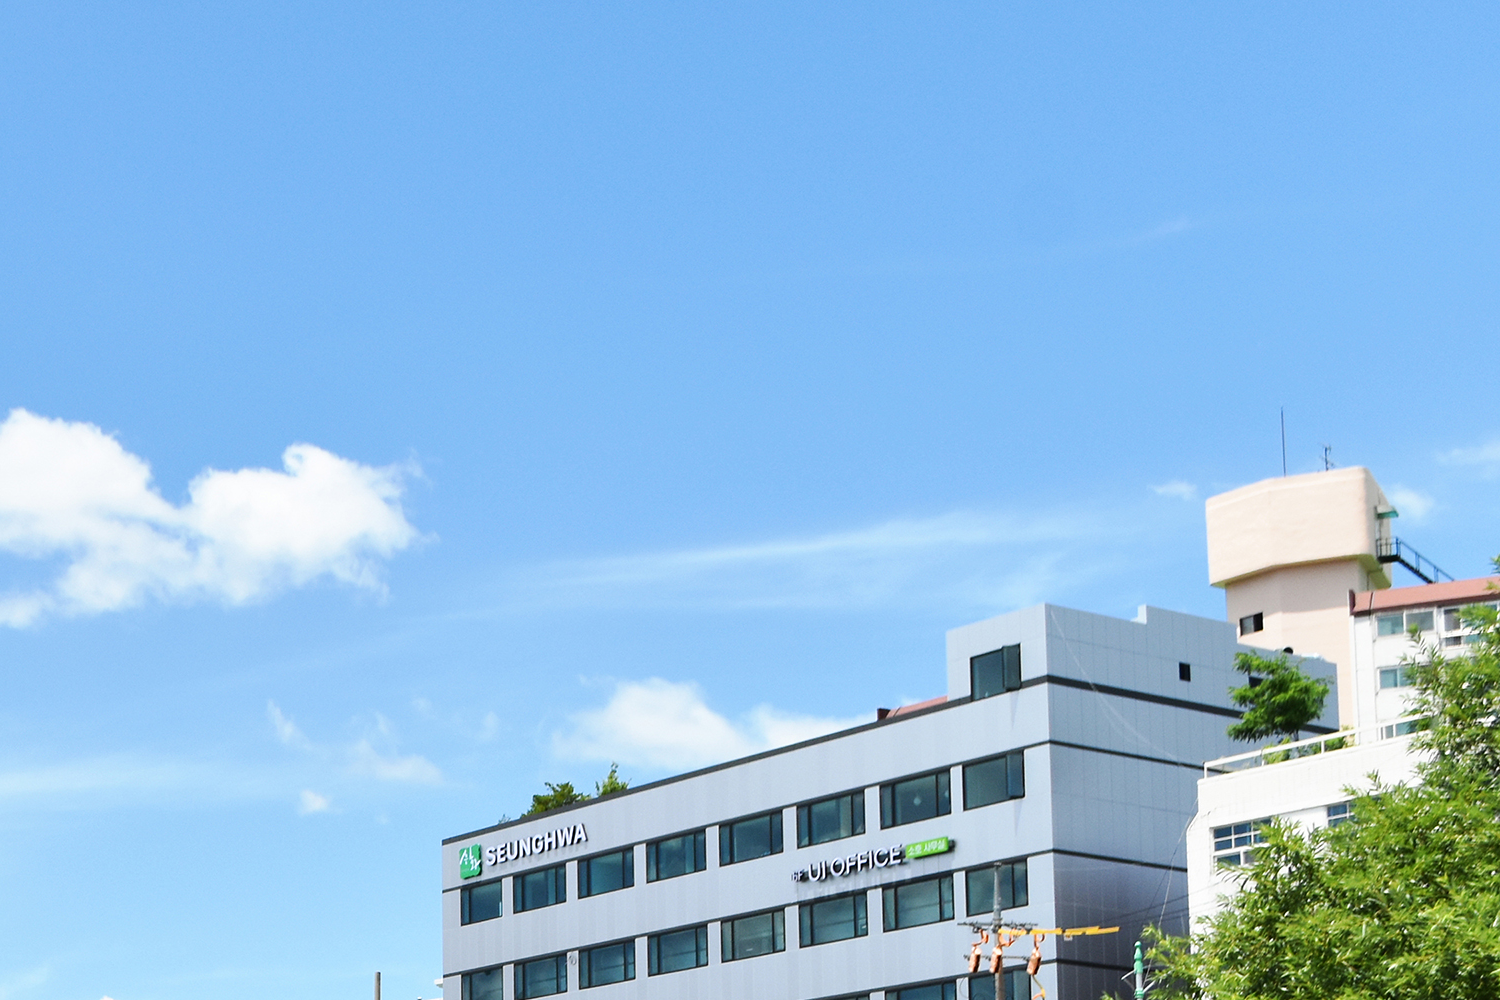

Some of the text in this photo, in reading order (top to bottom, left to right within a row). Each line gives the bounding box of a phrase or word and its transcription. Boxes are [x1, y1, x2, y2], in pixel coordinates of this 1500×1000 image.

[485, 823, 588, 866] SEUNGHWA
[808, 860, 826, 882] UI
[830, 844, 902, 877] OFFICE
